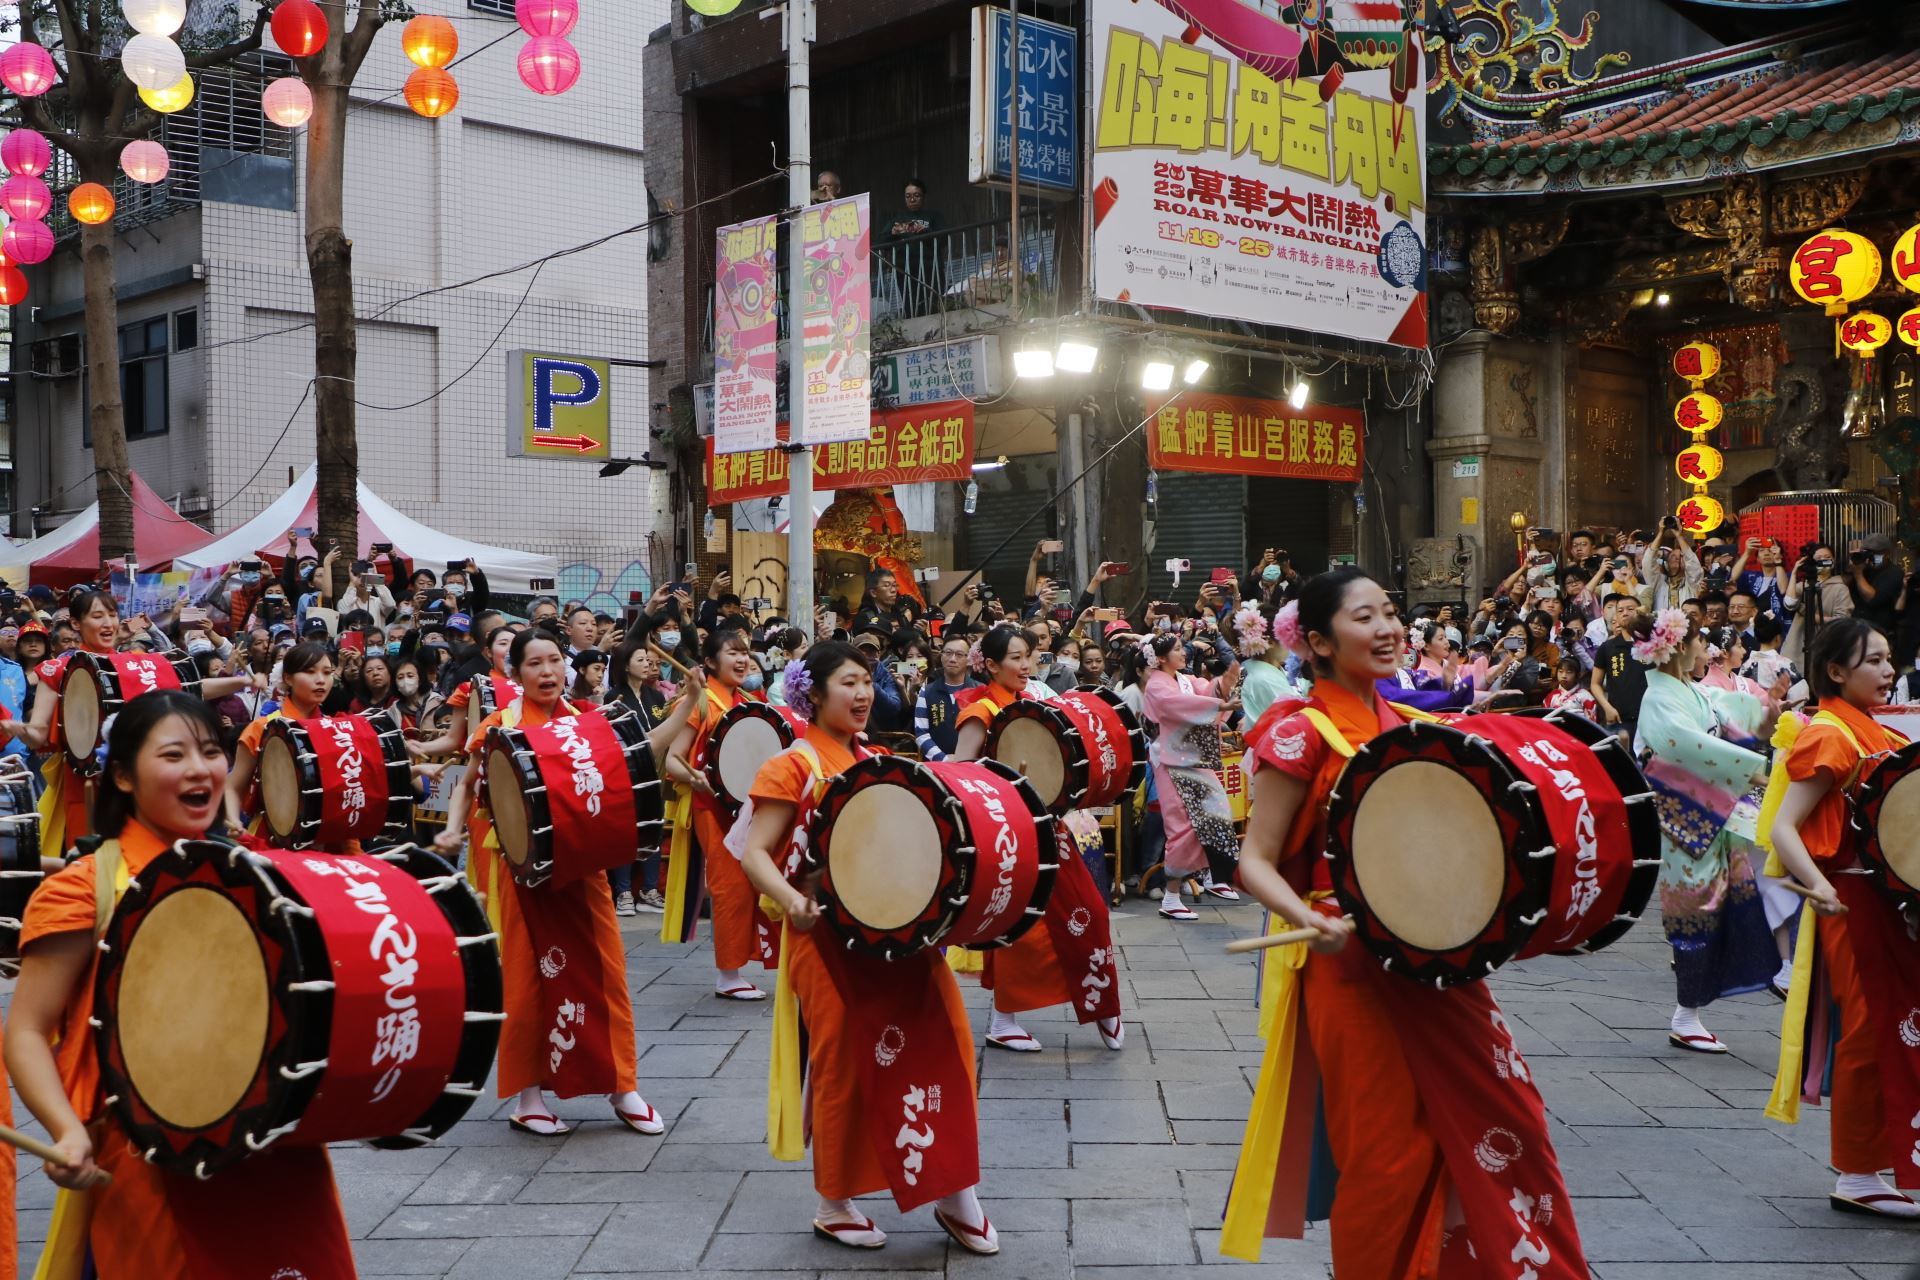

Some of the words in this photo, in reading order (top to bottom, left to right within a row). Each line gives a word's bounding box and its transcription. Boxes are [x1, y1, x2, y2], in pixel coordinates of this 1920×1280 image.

[1002, 26, 1069, 80] 流水
[1001, 84, 1070, 137] 盆景
[1153, 198, 1220, 223] ROAR
[1281, 226, 1382, 257] BANGKAH
[1186, 165, 1381, 242] 萬華大鬧熱
[1795, 234, 1853, 299] 宮
[1842, 320, 1879, 347] 秋
[533, 357, 601, 431] P
[719, 393, 772, 414] 大鬧熱
[1677, 397, 1710, 429] 泰
[1157, 406, 1358, 468] 艋舺青山宮服務處
[1679, 452, 1708, 480] 民
[1679, 500, 1709, 530] 安
[1081, 948, 1111, 1012] さんさ
[548, 997, 576, 1074] さんさ
[927, 1084, 942, 1113] 盛岡
[895, 1083, 935, 1187] さんさ
